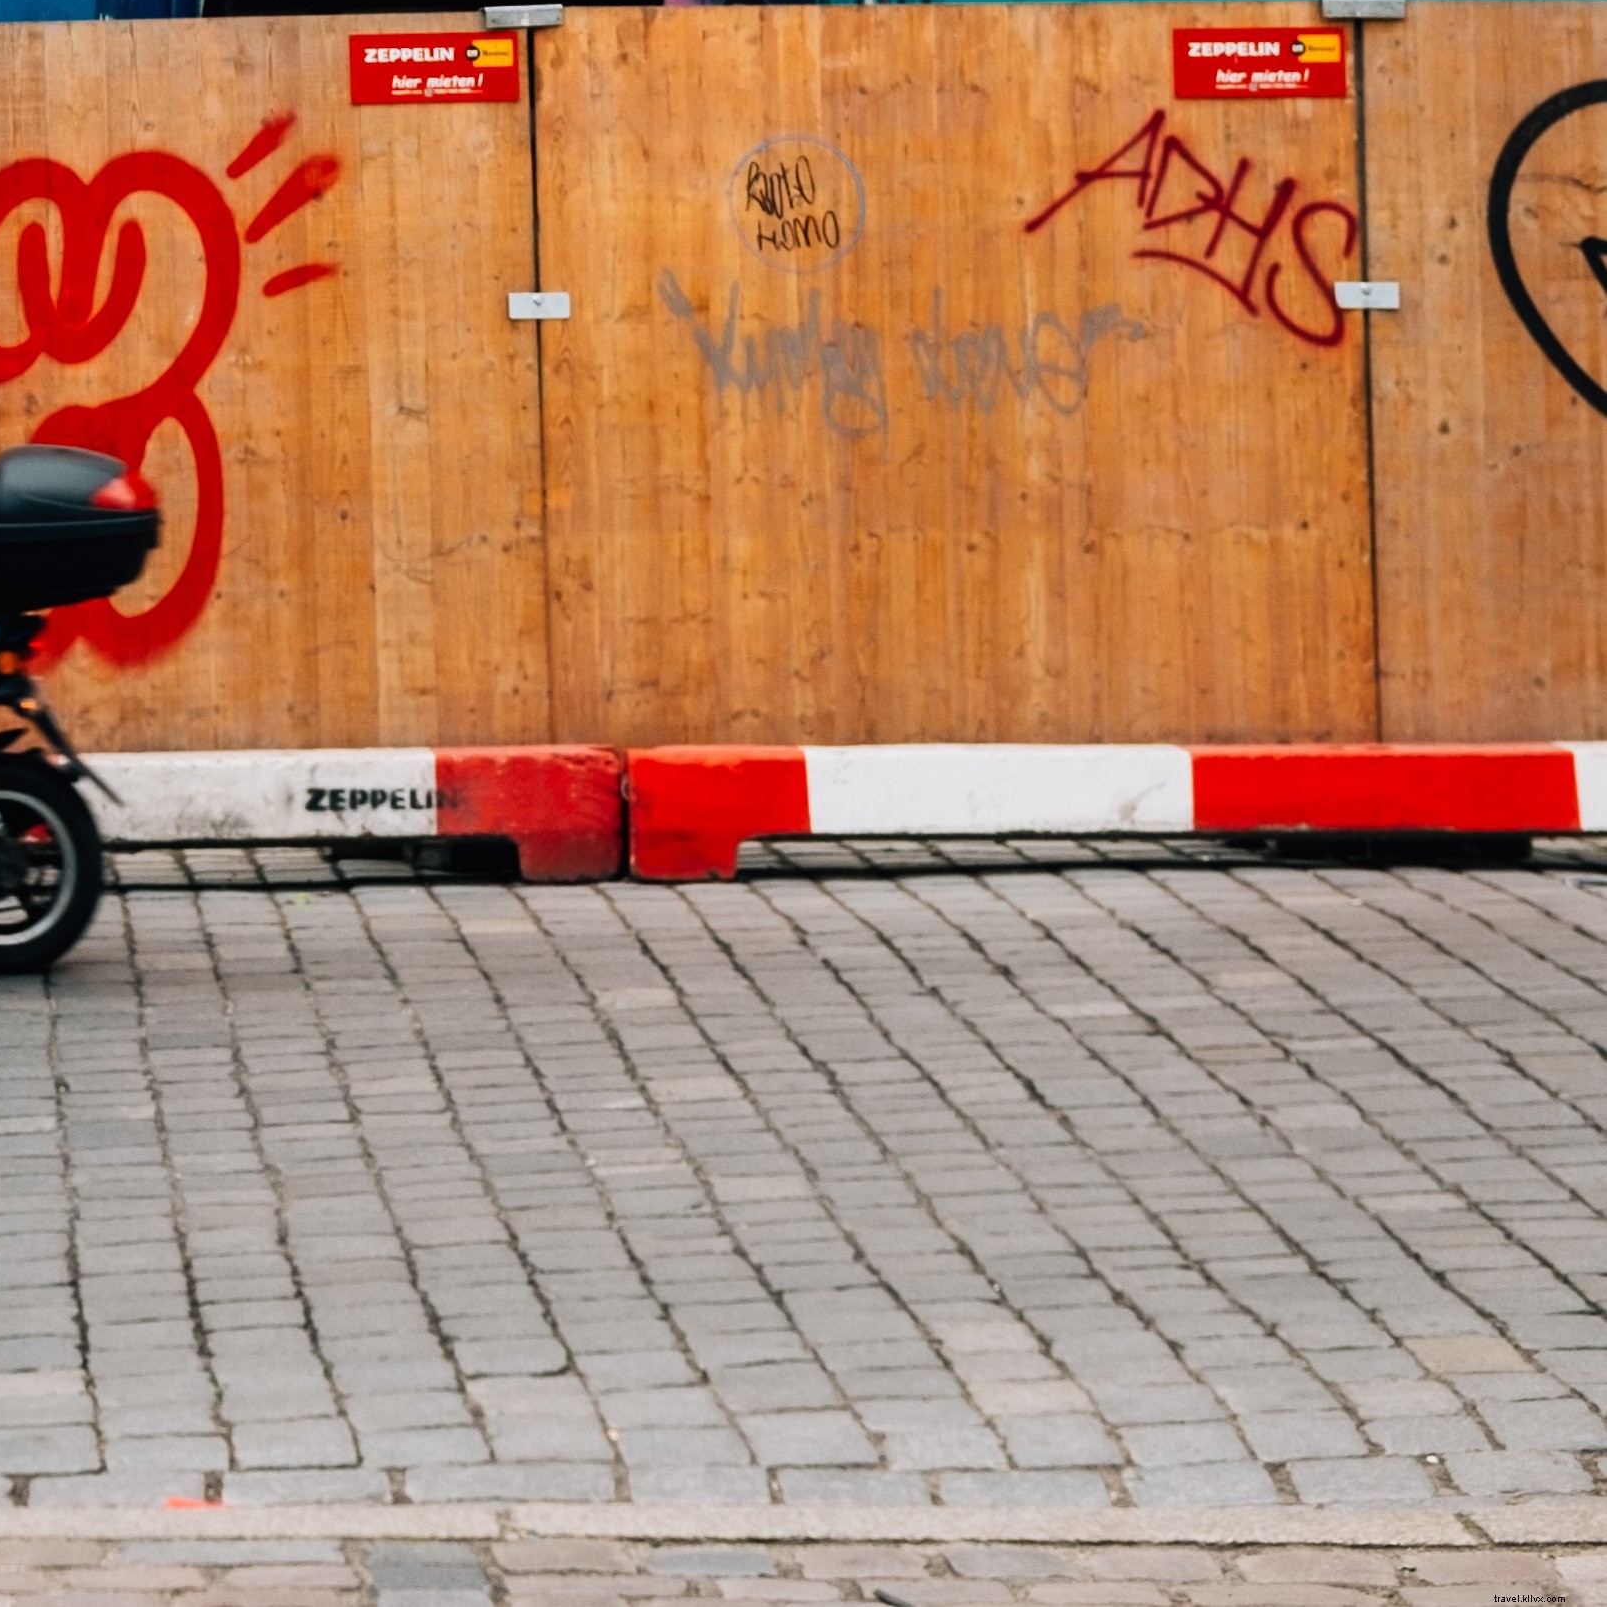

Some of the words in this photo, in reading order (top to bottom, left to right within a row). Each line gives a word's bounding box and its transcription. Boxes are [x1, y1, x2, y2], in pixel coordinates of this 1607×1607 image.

[364, 47, 455, 63] ZEPPELIN
[1188, 42, 1280, 57] ZEPPELIN
[392, 74, 422, 89] hier
[1216, 68, 1247, 83] hier
[1024, 108, 1359, 347] ADHS
[305, 788, 461, 811] ZEPPELIN
